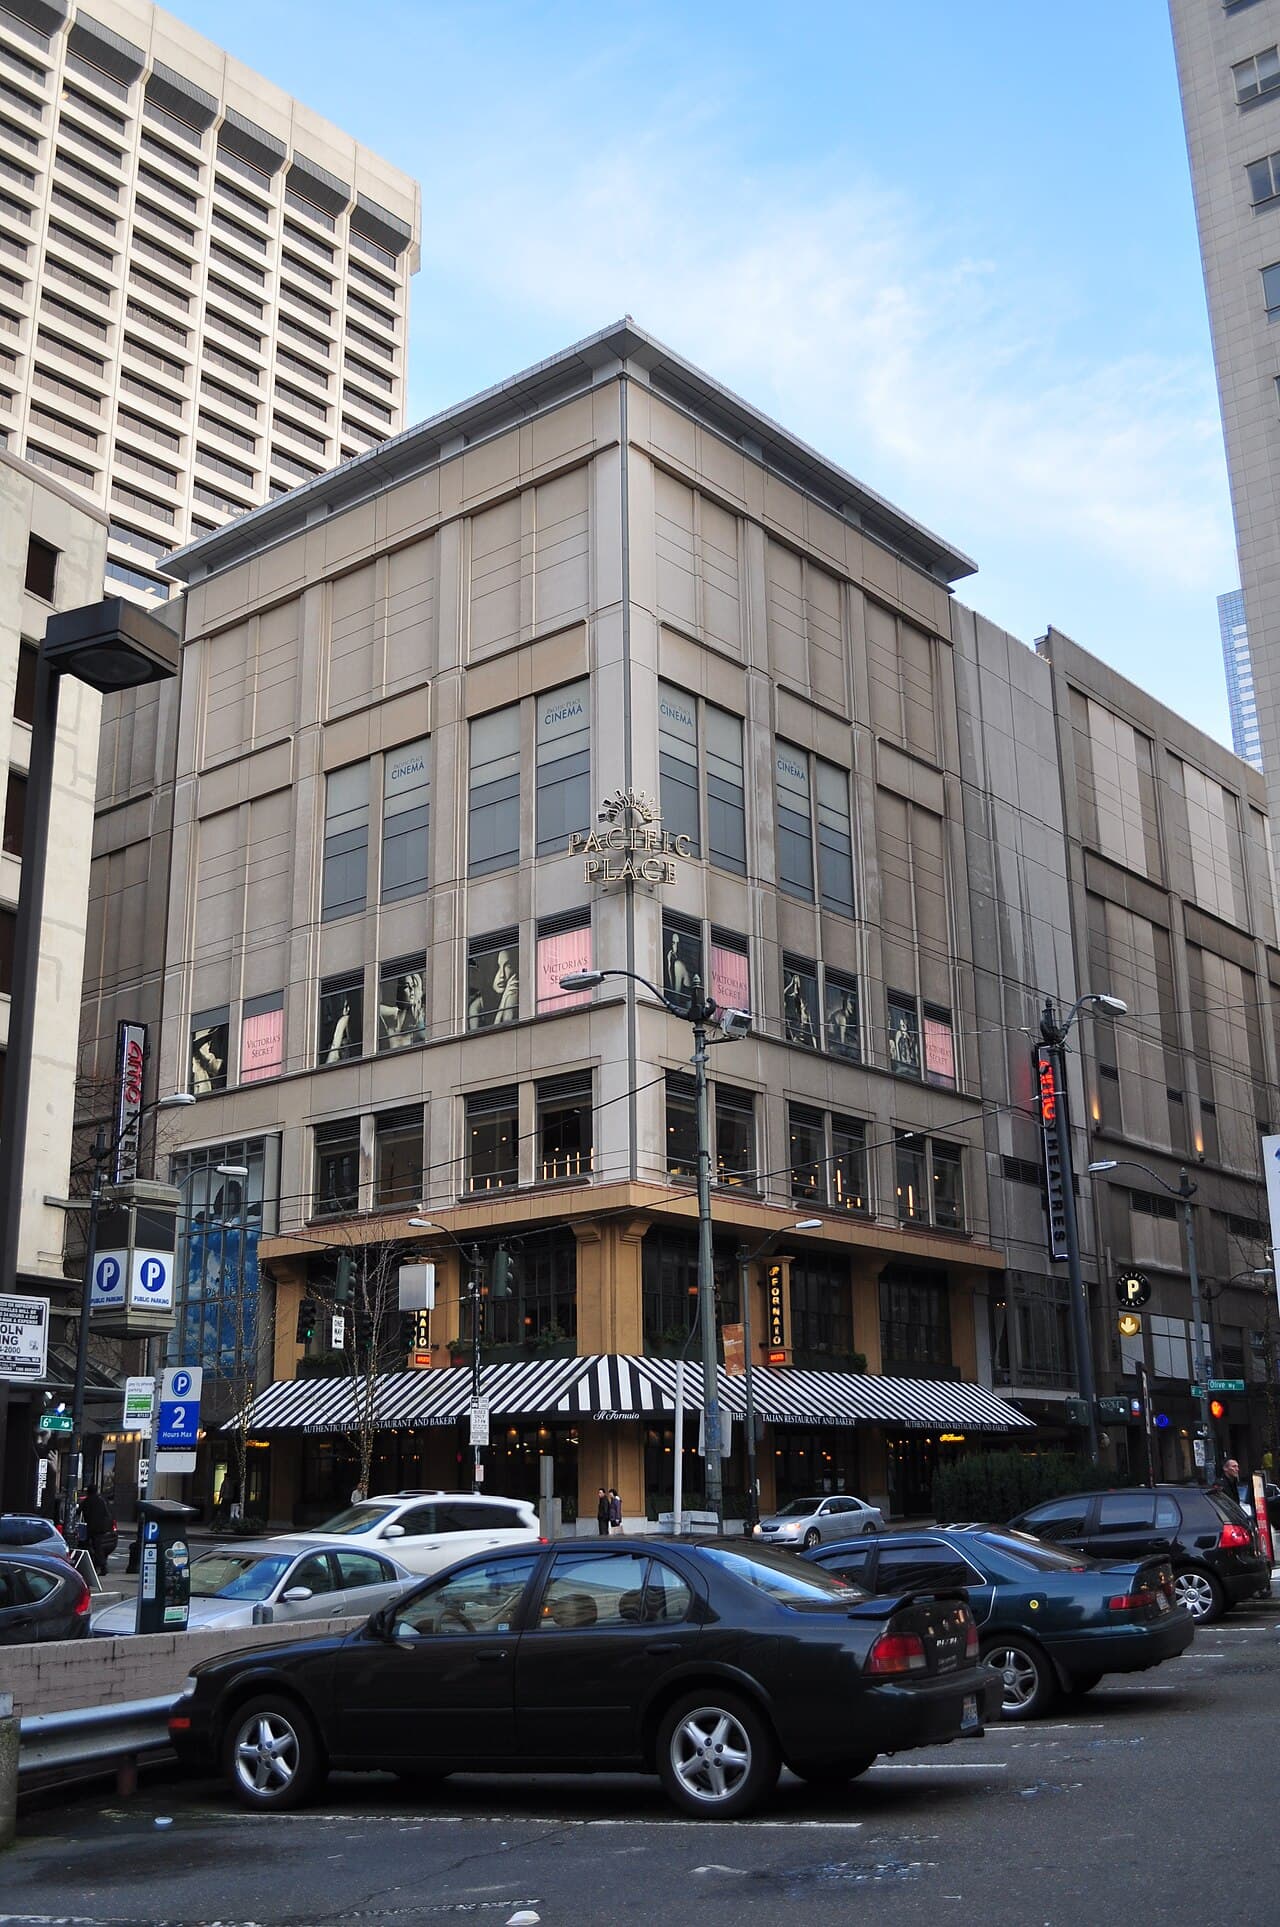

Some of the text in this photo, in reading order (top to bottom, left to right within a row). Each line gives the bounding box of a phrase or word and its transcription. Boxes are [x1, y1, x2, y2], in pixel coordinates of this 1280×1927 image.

[544, 704, 583, 725] CINEMA
[660, 704, 694, 727] CINEMA
[391, 761, 425, 780] CINEMA
[777, 760, 806, 781] CINEMA
[568, 827, 691, 858] PACIFIC
[584, 859, 678, 885] PLACE
[543, 955, 588, 975] VICTORIA'S
[717, 983, 741, 1001] SECRET
[251, 1046, 274, 1058] SECRET
[1048, 1128, 1067, 1243] THEATRES
[1127, 1279, 1139, 1299] P
[90, 1295, 124, 1304] PUBLIC PARKING
[133, 1295, 169, 1305] PUBLIC PARKING
[1120, 1296, 1145, 1306] PLACE
[771, 1277, 781, 1345] FORNAIO
[0, 1324, 23, 1336] OLN
[334, 1319, 343, 1327] ONE
[418, 1310, 428, 1347] NAIO
[0, 1335, 19, 1345] ING
[1209, 1380, 1226, 1389] Olive
[171, 1406, 186, 1429] 2
[605, 1409, 640, 1420] Fornaio
[762, 1413, 856, 1427] TALIAN RESTAURANT AND BAKERY
[303, 1423, 341, 1434] AUTHENTIC
[413, 1417, 430, 1427] AND
[429, 1416, 458, 1427] BAKERY
[162, 1431, 192, 1439] Hours Max
